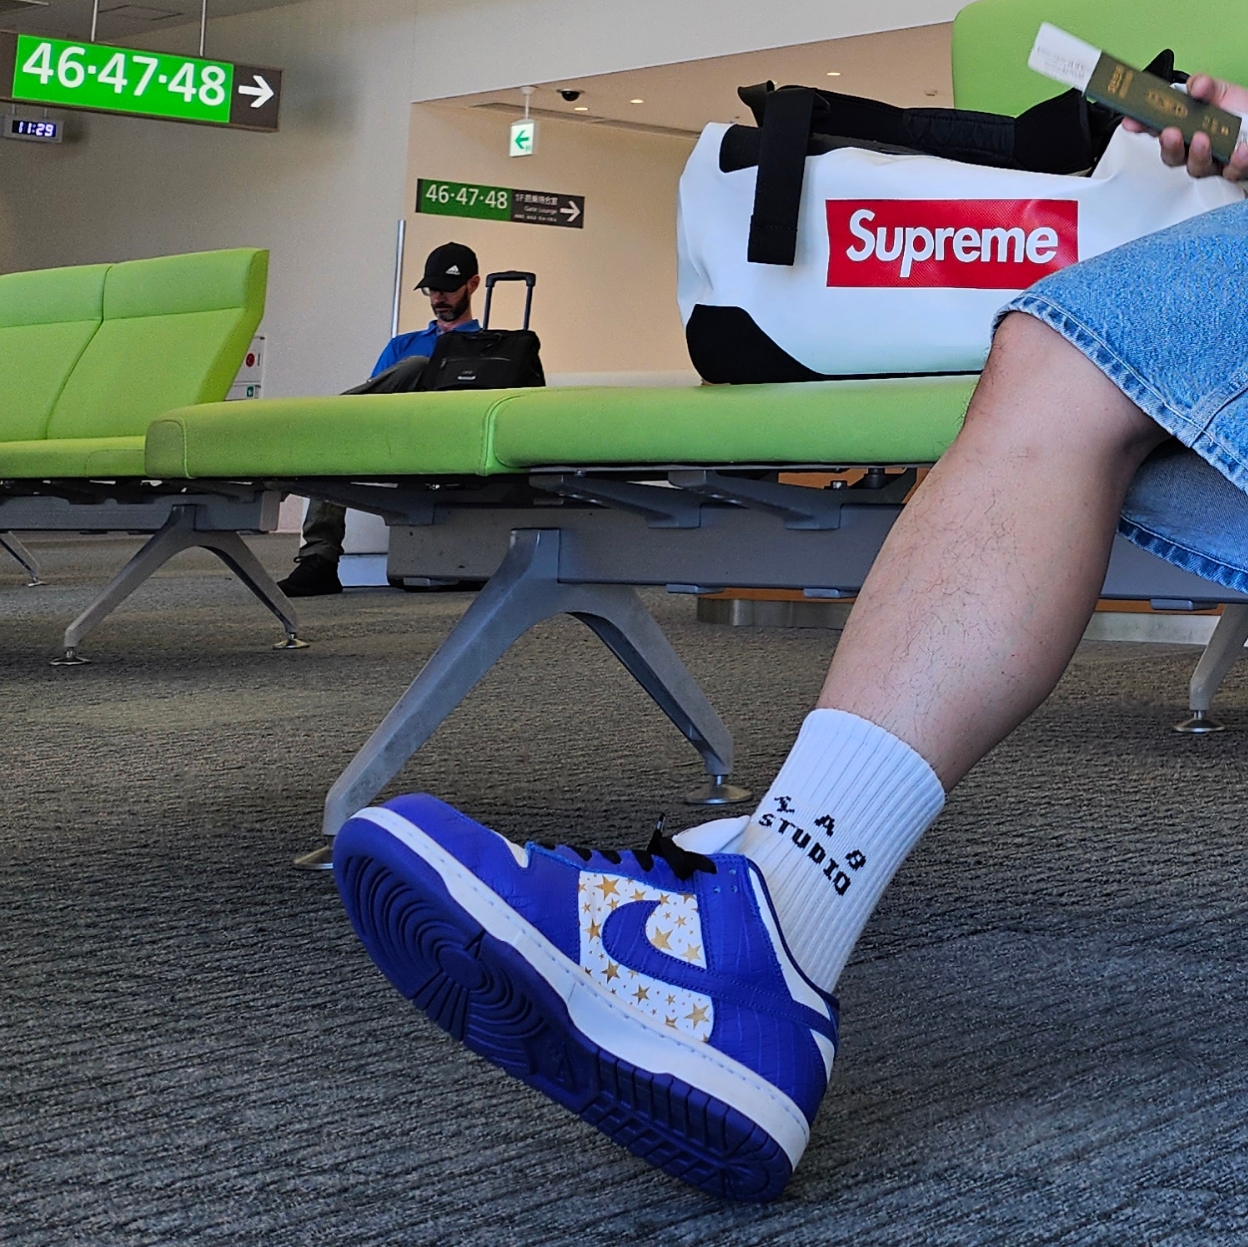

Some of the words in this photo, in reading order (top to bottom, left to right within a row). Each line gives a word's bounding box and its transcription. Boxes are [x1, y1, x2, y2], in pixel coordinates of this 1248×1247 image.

[18, 121, 54, 137] 11:29
[846, 209, 1059, 278] Supreme
[759, 813, 851, 896] STUDIO
